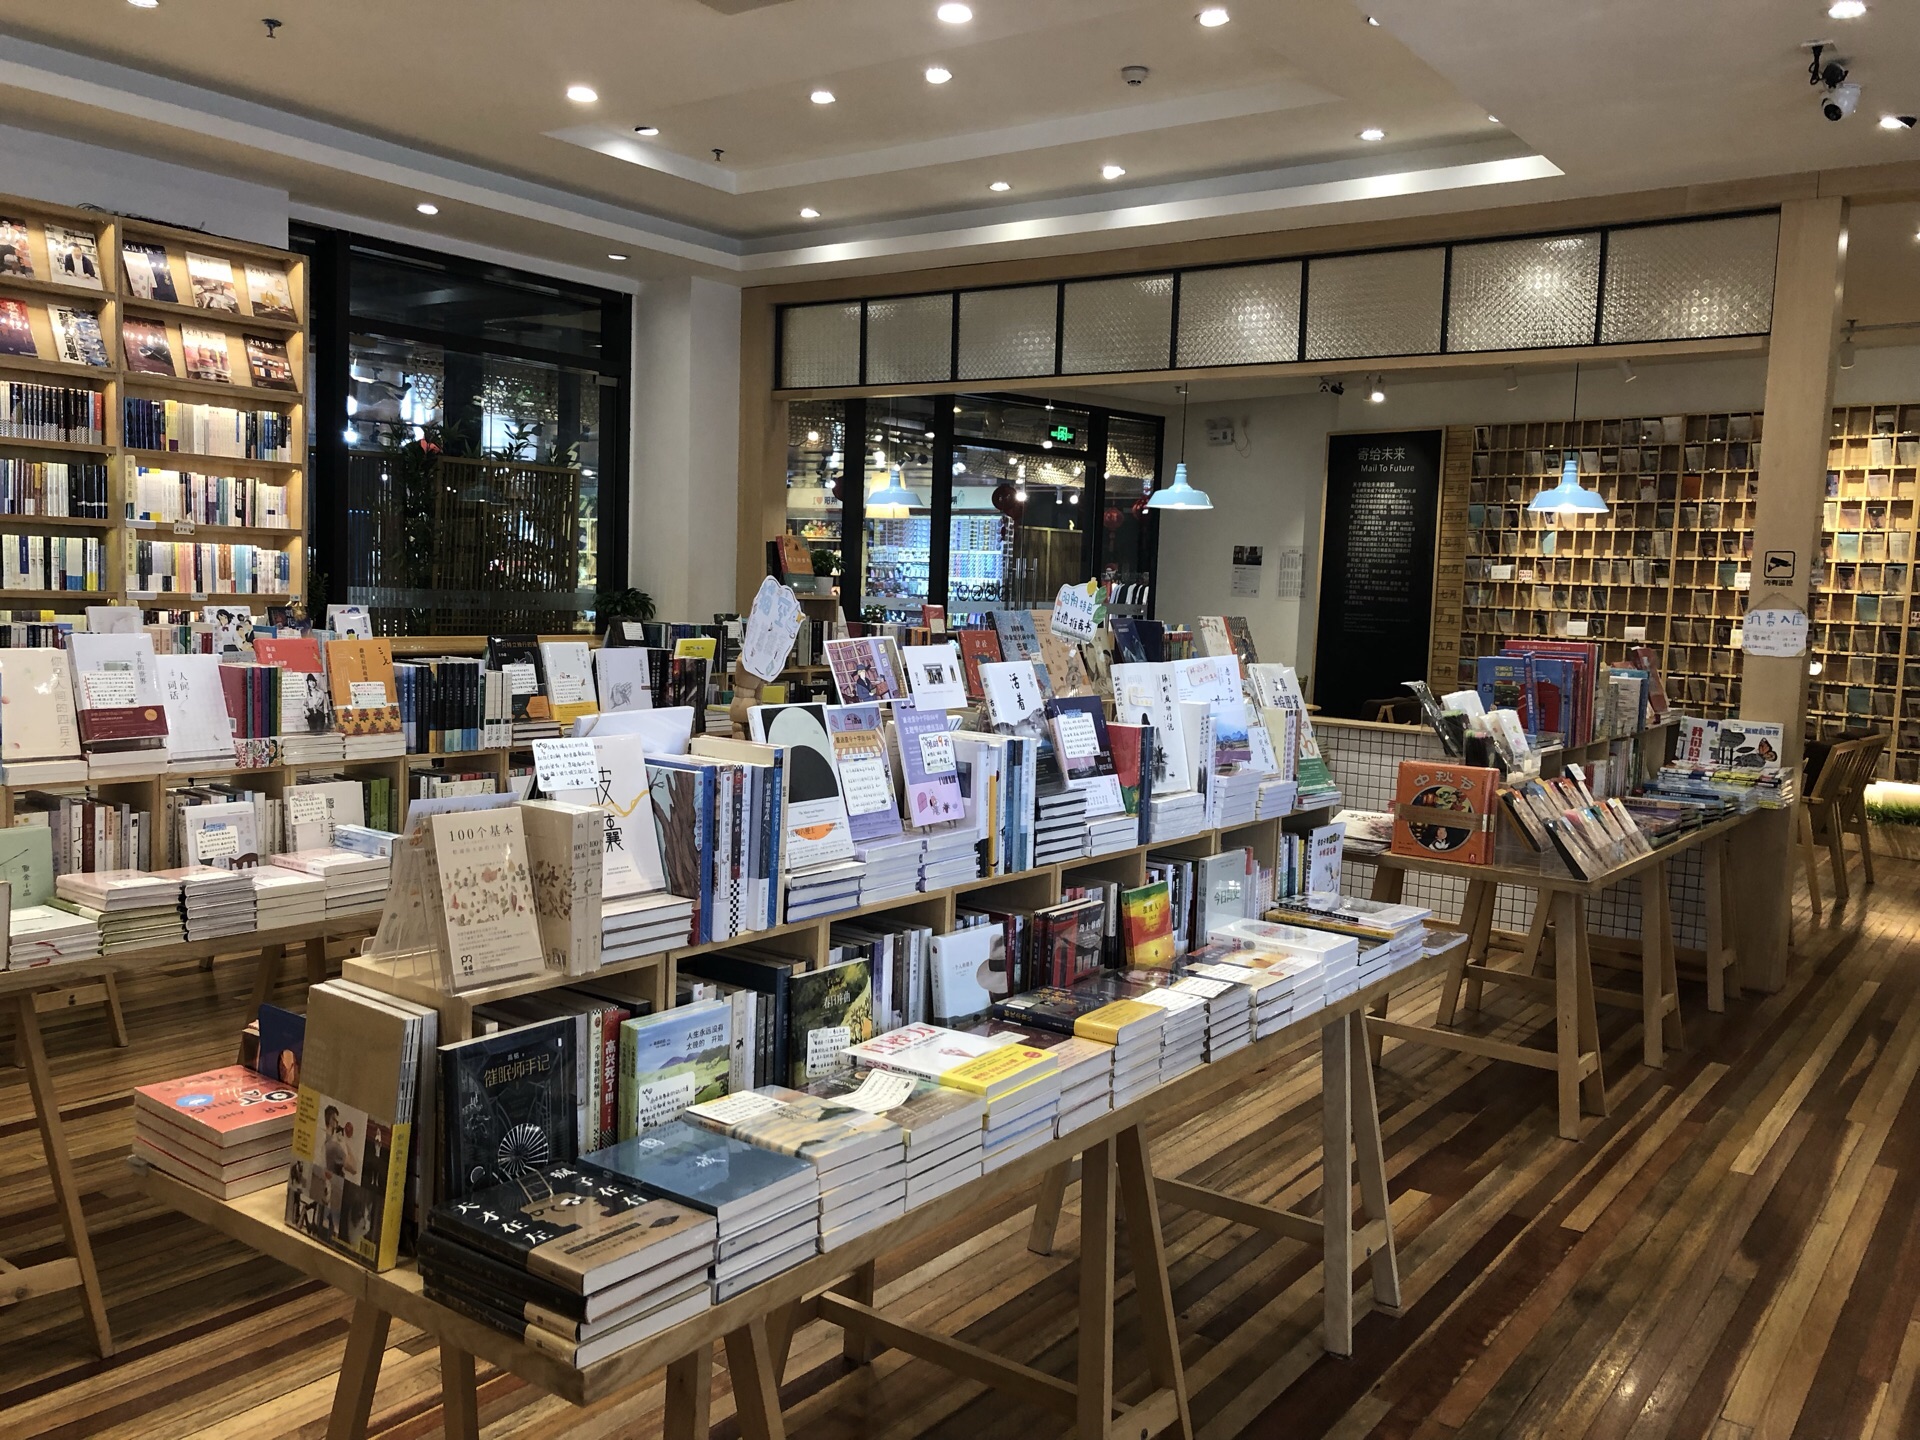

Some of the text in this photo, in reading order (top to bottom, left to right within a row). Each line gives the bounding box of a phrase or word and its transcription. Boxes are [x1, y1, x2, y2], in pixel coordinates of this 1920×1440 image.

[1357, 447, 1406, 461] 寄给未来
[1361, 463, 1415, 472] Mail To Future
[1763, 579, 1794, 587] 内有监控
[1062, 590, 1094, 616] 阳朔特色
[1054, 610, 1093, 633] 本地推荐书
[50, 655, 72, 749] 你是人间的四月天
[1009, 673, 1026, 711] 活着
[1413, 769, 1477, 791] 中秋节
[449, 823, 514, 842] 100个基本
[686, 1033, 724, 1051] 太晚的 开始
[687, 1023, 724, 1041] 人生永远没有
[483, 1053, 551, 1088] 催眠师手记
[549, 1166, 648, 1207] 疯子在右
[454, 1200, 555, 1246] 天才在左
